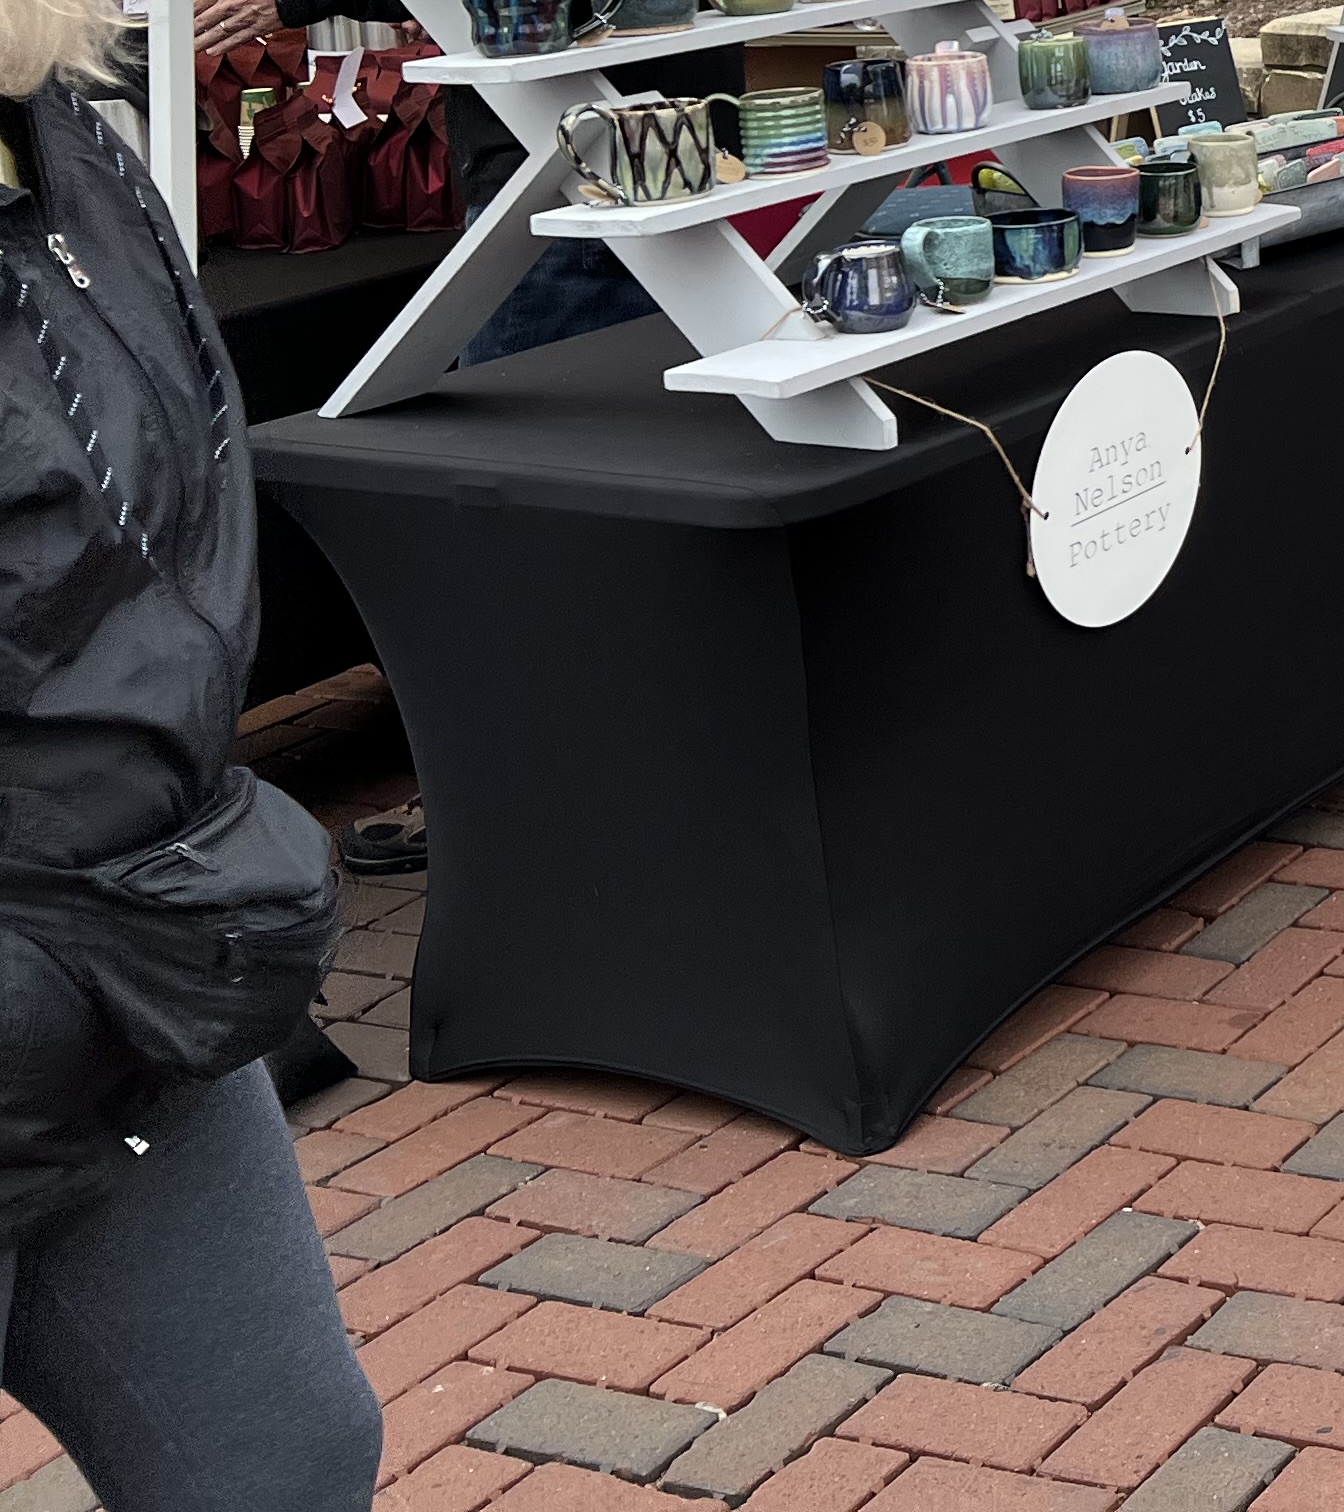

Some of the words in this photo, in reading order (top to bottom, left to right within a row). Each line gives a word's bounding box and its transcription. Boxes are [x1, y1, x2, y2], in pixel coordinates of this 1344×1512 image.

[1180, 87, 1217, 106] akes
[1187, 107, 1206, 123] $5
[1088, 431, 1149, 474] Anya
[1074, 459, 1164, 517] Nelson
[1069, 502, 1172, 569] Pottery
